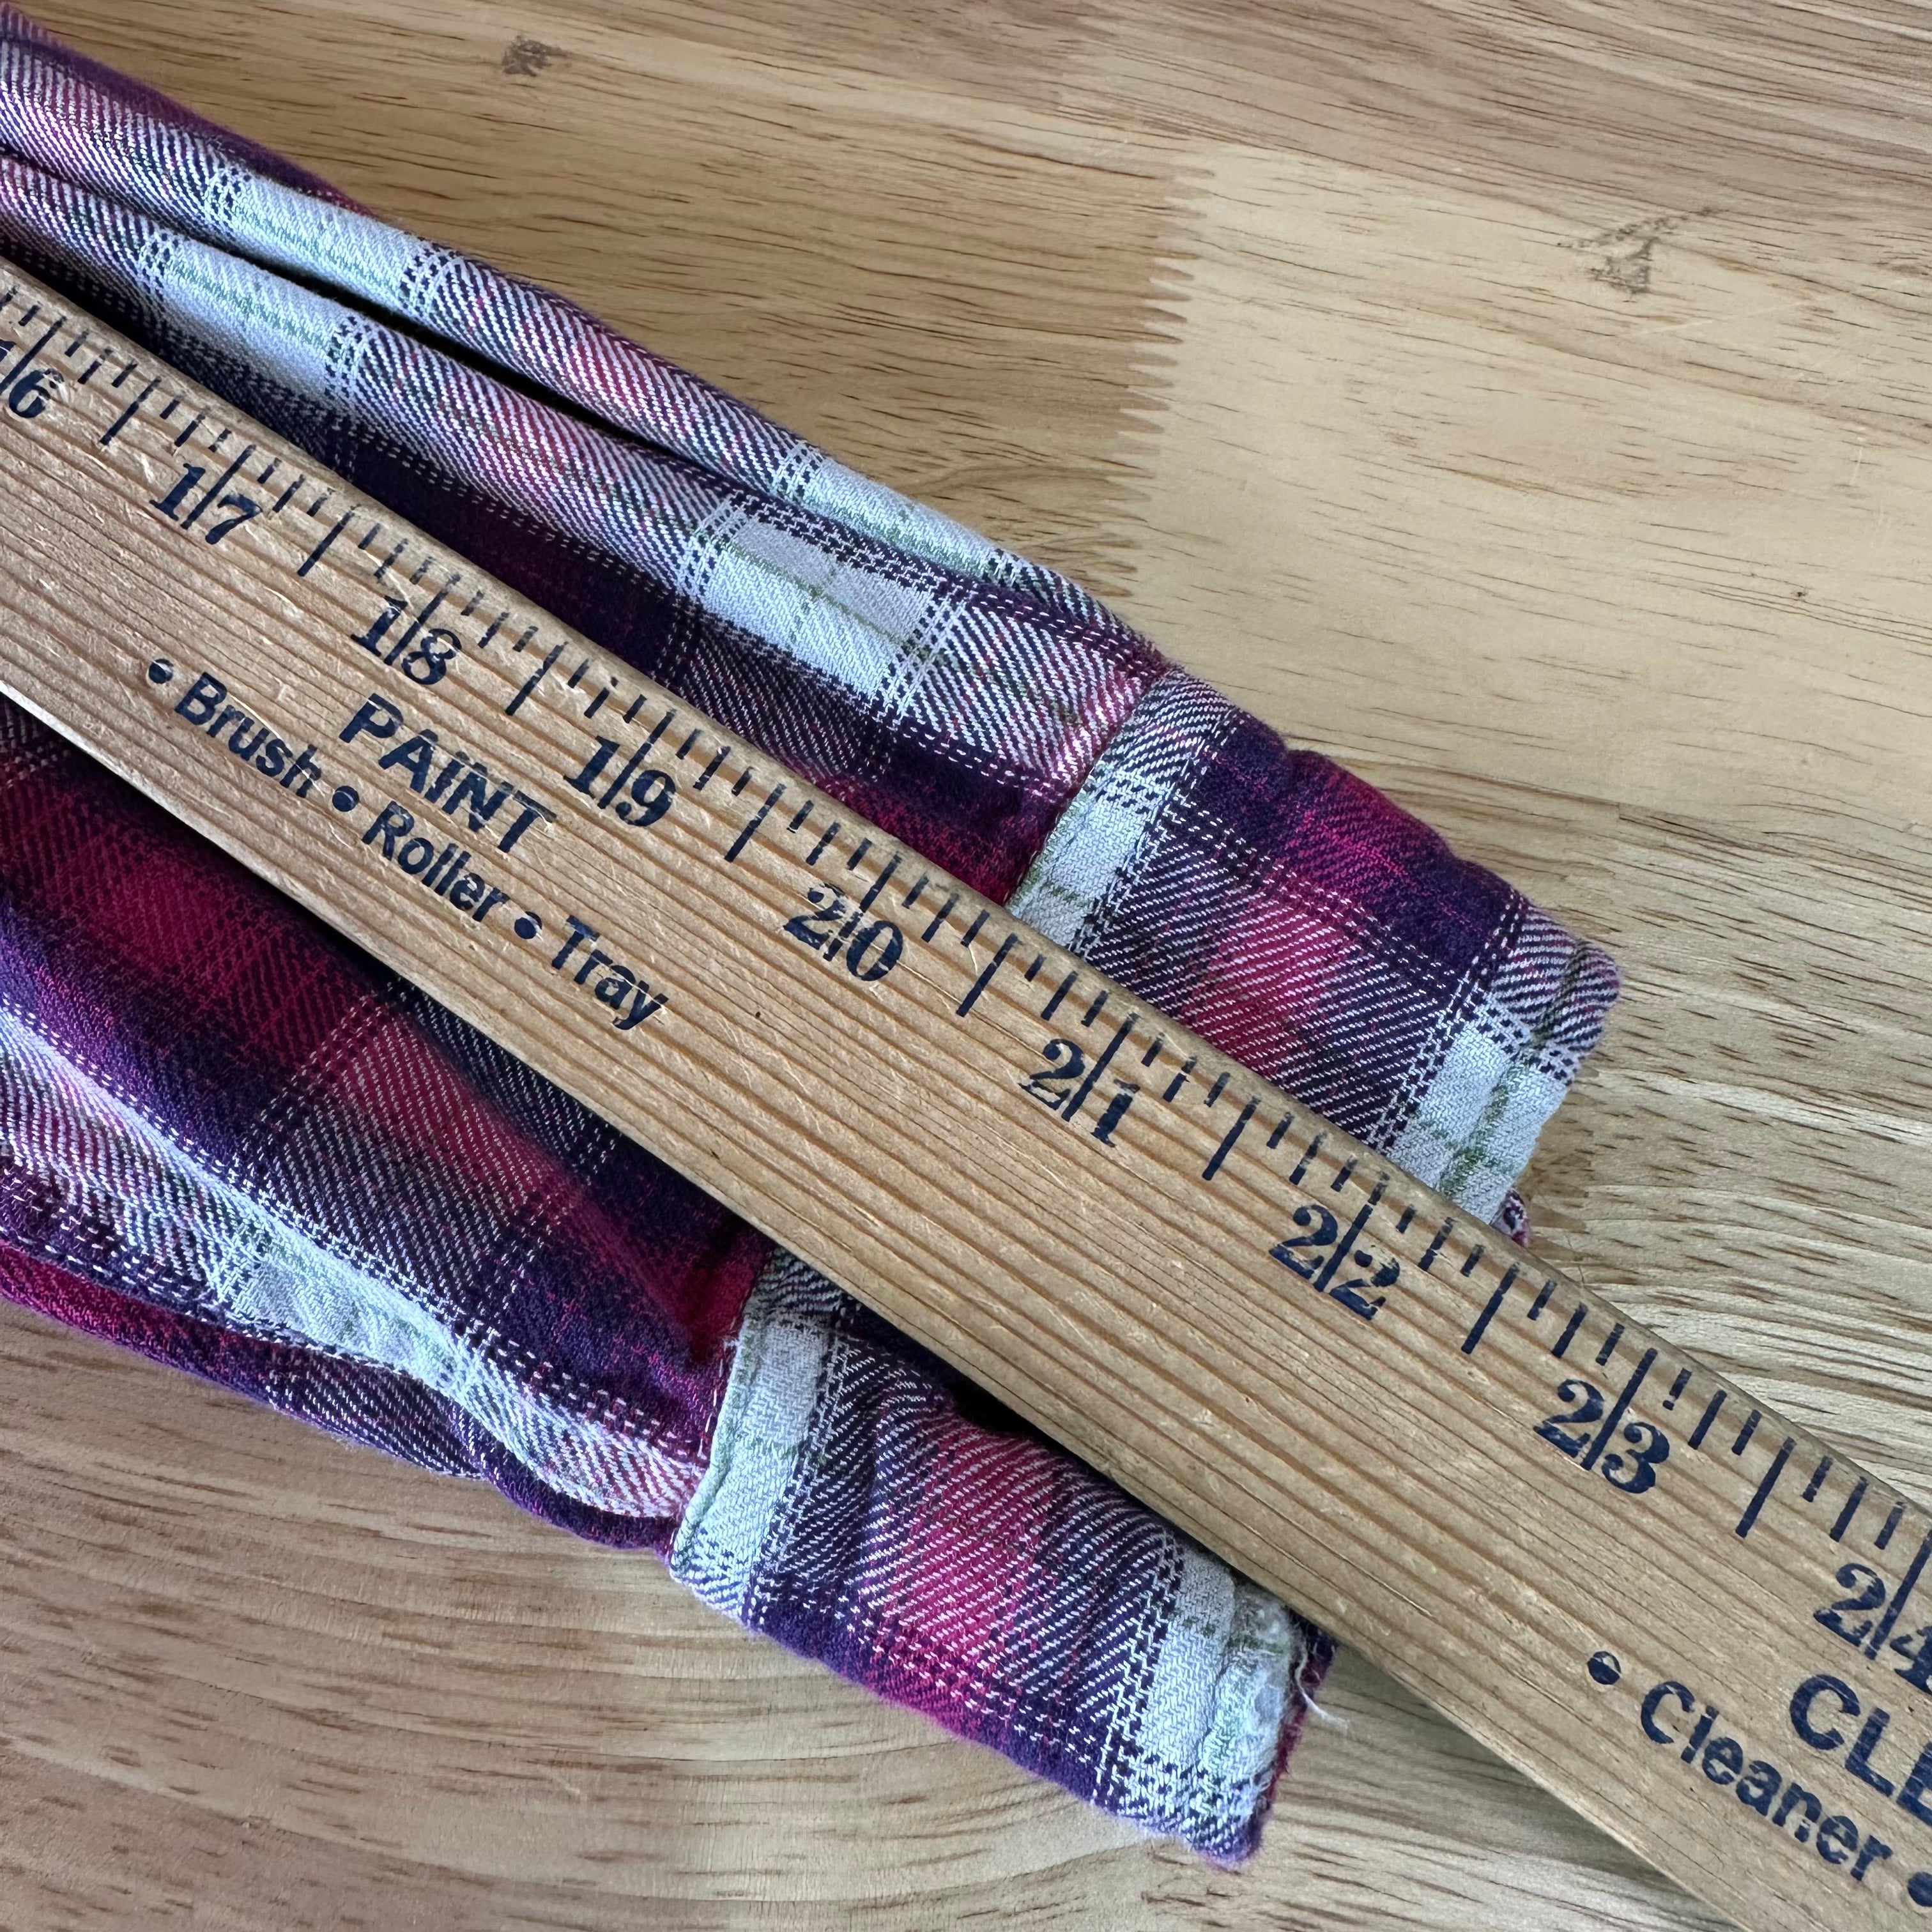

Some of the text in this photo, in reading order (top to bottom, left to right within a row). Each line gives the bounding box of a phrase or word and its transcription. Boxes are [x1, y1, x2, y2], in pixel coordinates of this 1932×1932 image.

[174, 672, 669, 1031] Brush Roller Tray
[339, 693, 557, 854] PAINT
[150, 463, 263, 544] 17
[351, 595, 462, 686] 18
[564, 735, 675, 827] 19
[783, 883, 903, 982] 20
[1019, 1039, 1140, 1148] 21
[1269, 1204, 1400, 1321] 22
[1534, 1378, 1669, 1494] 23
[1640, 1680, 1894, 1882] Cleaner
